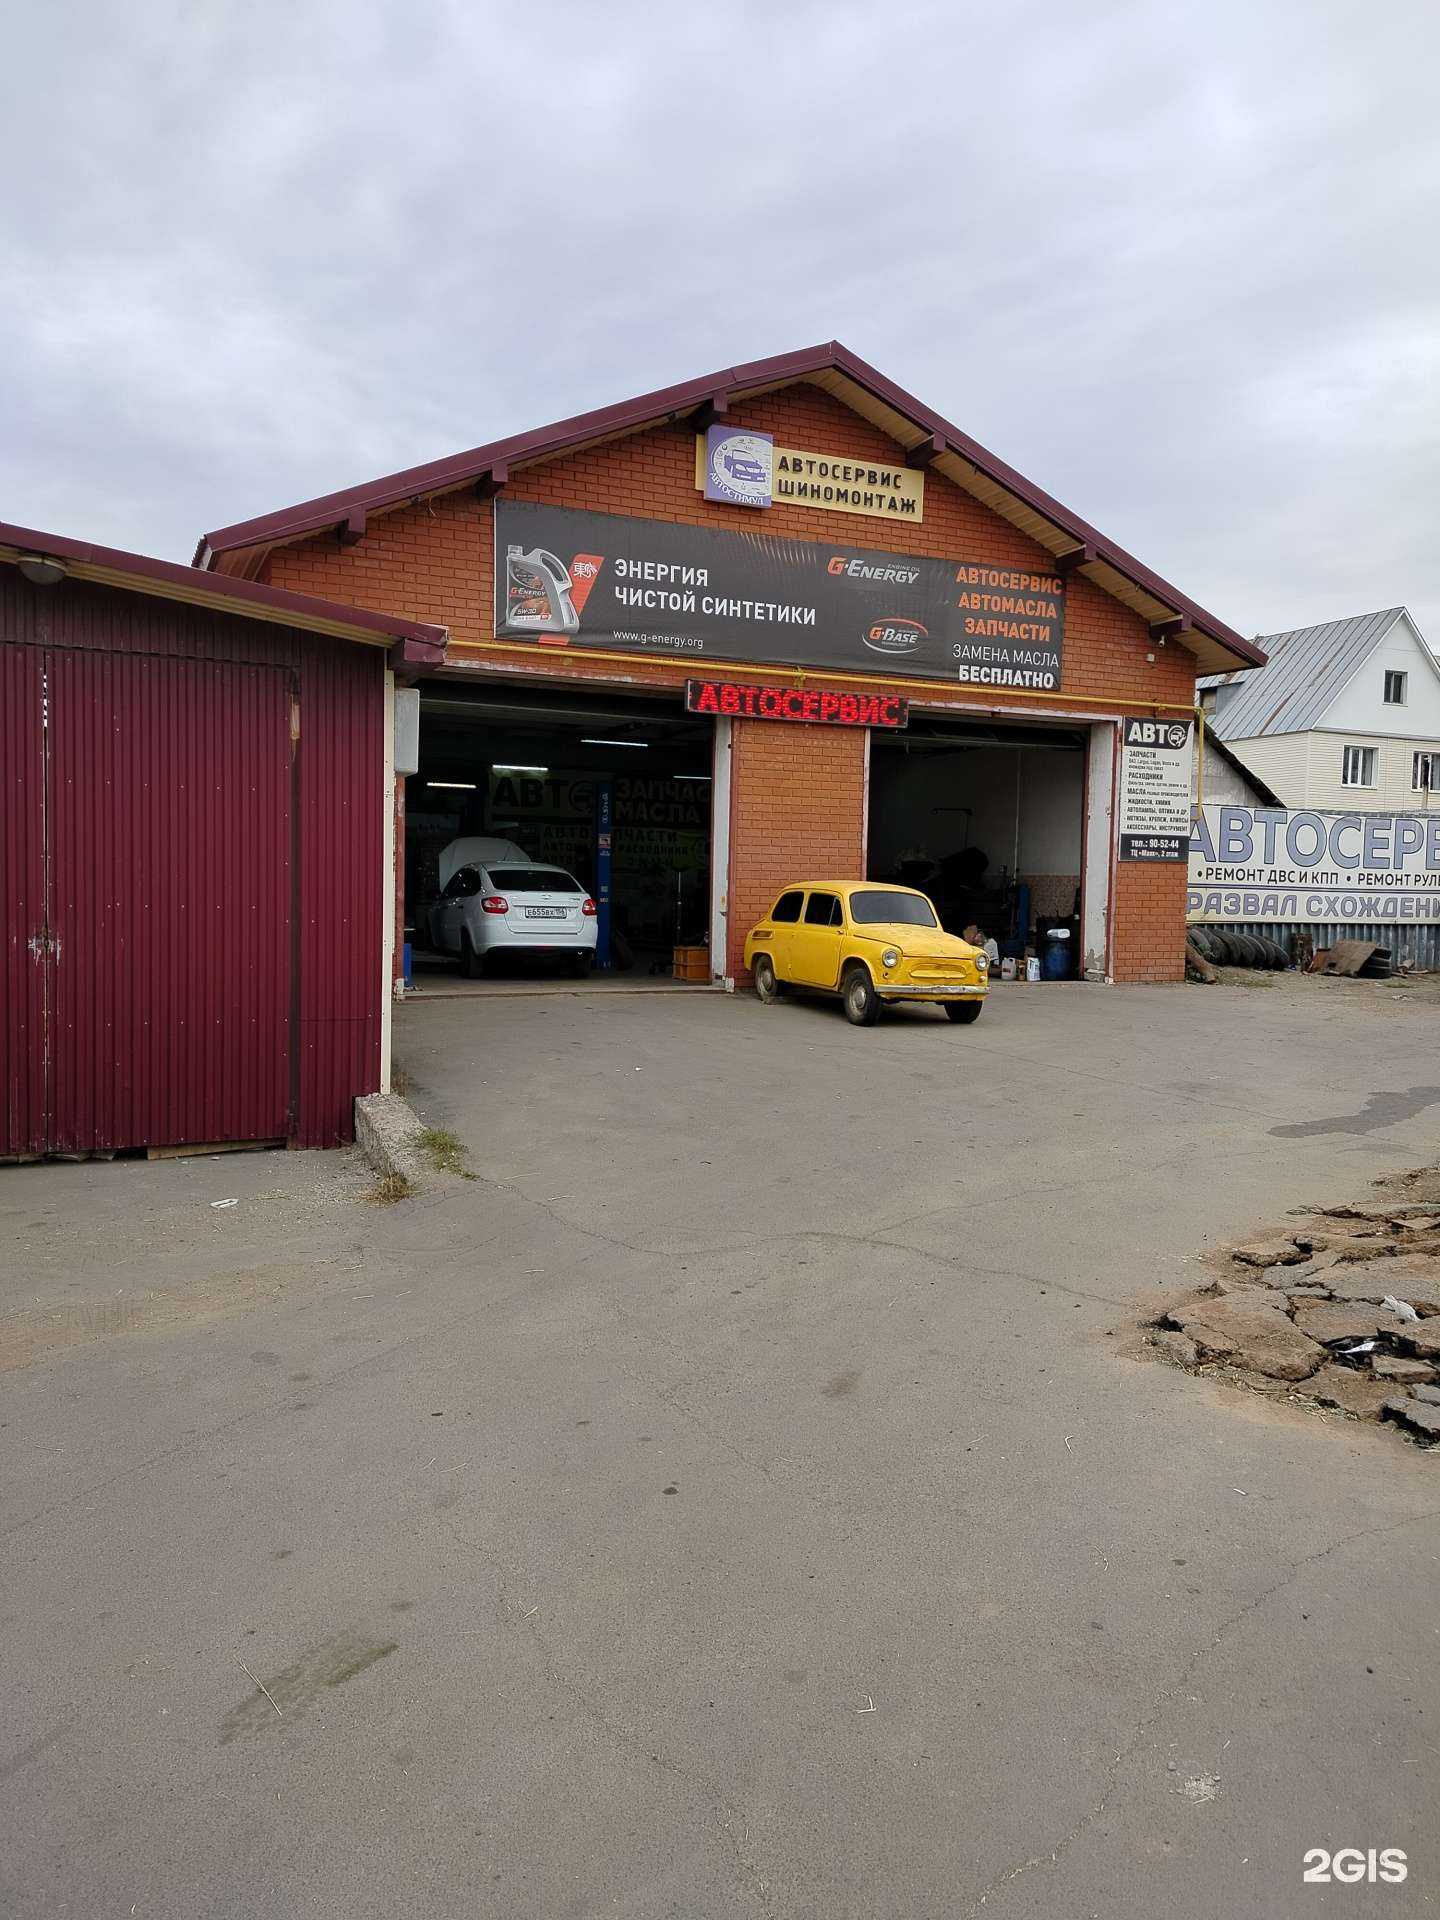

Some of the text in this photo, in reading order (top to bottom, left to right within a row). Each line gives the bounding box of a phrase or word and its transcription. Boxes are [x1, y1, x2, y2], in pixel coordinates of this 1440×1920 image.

[777, 455, 902, 489] АВТОСЕРВИС
[709, 471, 764, 505] АВТОСТИМУЛ
[777, 478, 916, 514] ШИНОМОНТАЖ
[614, 558, 708, 587] ЭНЕРГИЯ
[956, 566, 1062, 595] АВТОСЕРВИС
[614, 586, 816, 626] ЧИСТОЙ СИНТЕТИКИ
[958, 591, 1057, 619] АВТОМАСЛА
[613, 630, 704, 650] www.g-energy.org
[964, 617, 1051, 642] ЗАПЧАСТИ
[952, 643, 1059, 668] ЗАМЕНА МАСЛА
[959, 664, 1054, 689] БЕСПЛАТНО
[697, 682, 900, 725] АВТОСЕРВИС
[1129, 750, 1157, 759] ЗАПЧАСТИ
[1128, 772, 1164, 780] РАСХОДНИКИ
[1149, 838, 1179, 849] 90-52-44
[1205, 867, 1264, 881] РЕМОНТ
[1267, 870, 1296, 884] ДВС
[1299, 871, 1308, 884] И
[1311, 871, 1339, 885] КПП
[1358, 873, 1411, 886] РЕМОНТ
[1187, 892, 1297, 917] РАЗВАЛ
